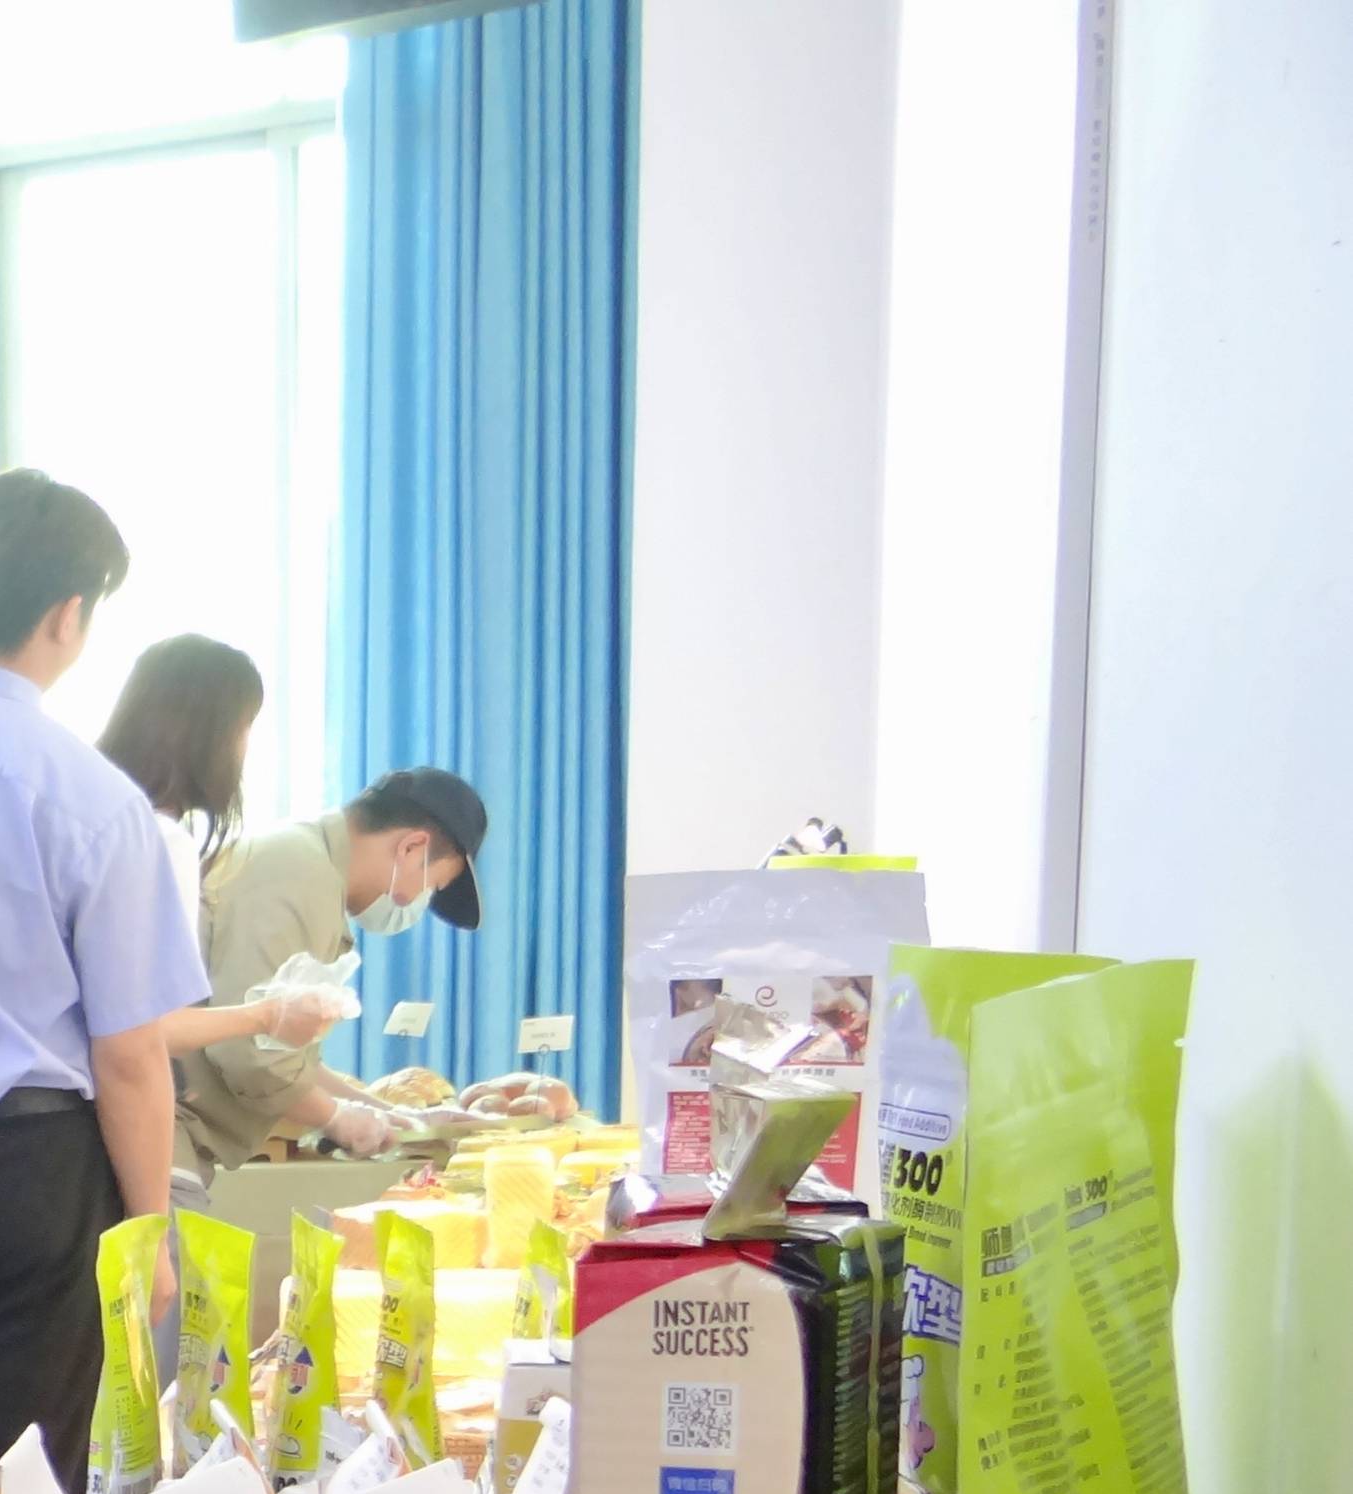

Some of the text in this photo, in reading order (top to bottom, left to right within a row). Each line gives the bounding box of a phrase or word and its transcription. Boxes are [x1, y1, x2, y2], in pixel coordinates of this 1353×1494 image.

[893, 1147, 943, 1197] 300
[653, 1299, 750, 1328] INSTANT
[651, 1326, 752, 1357] SUCCESS
